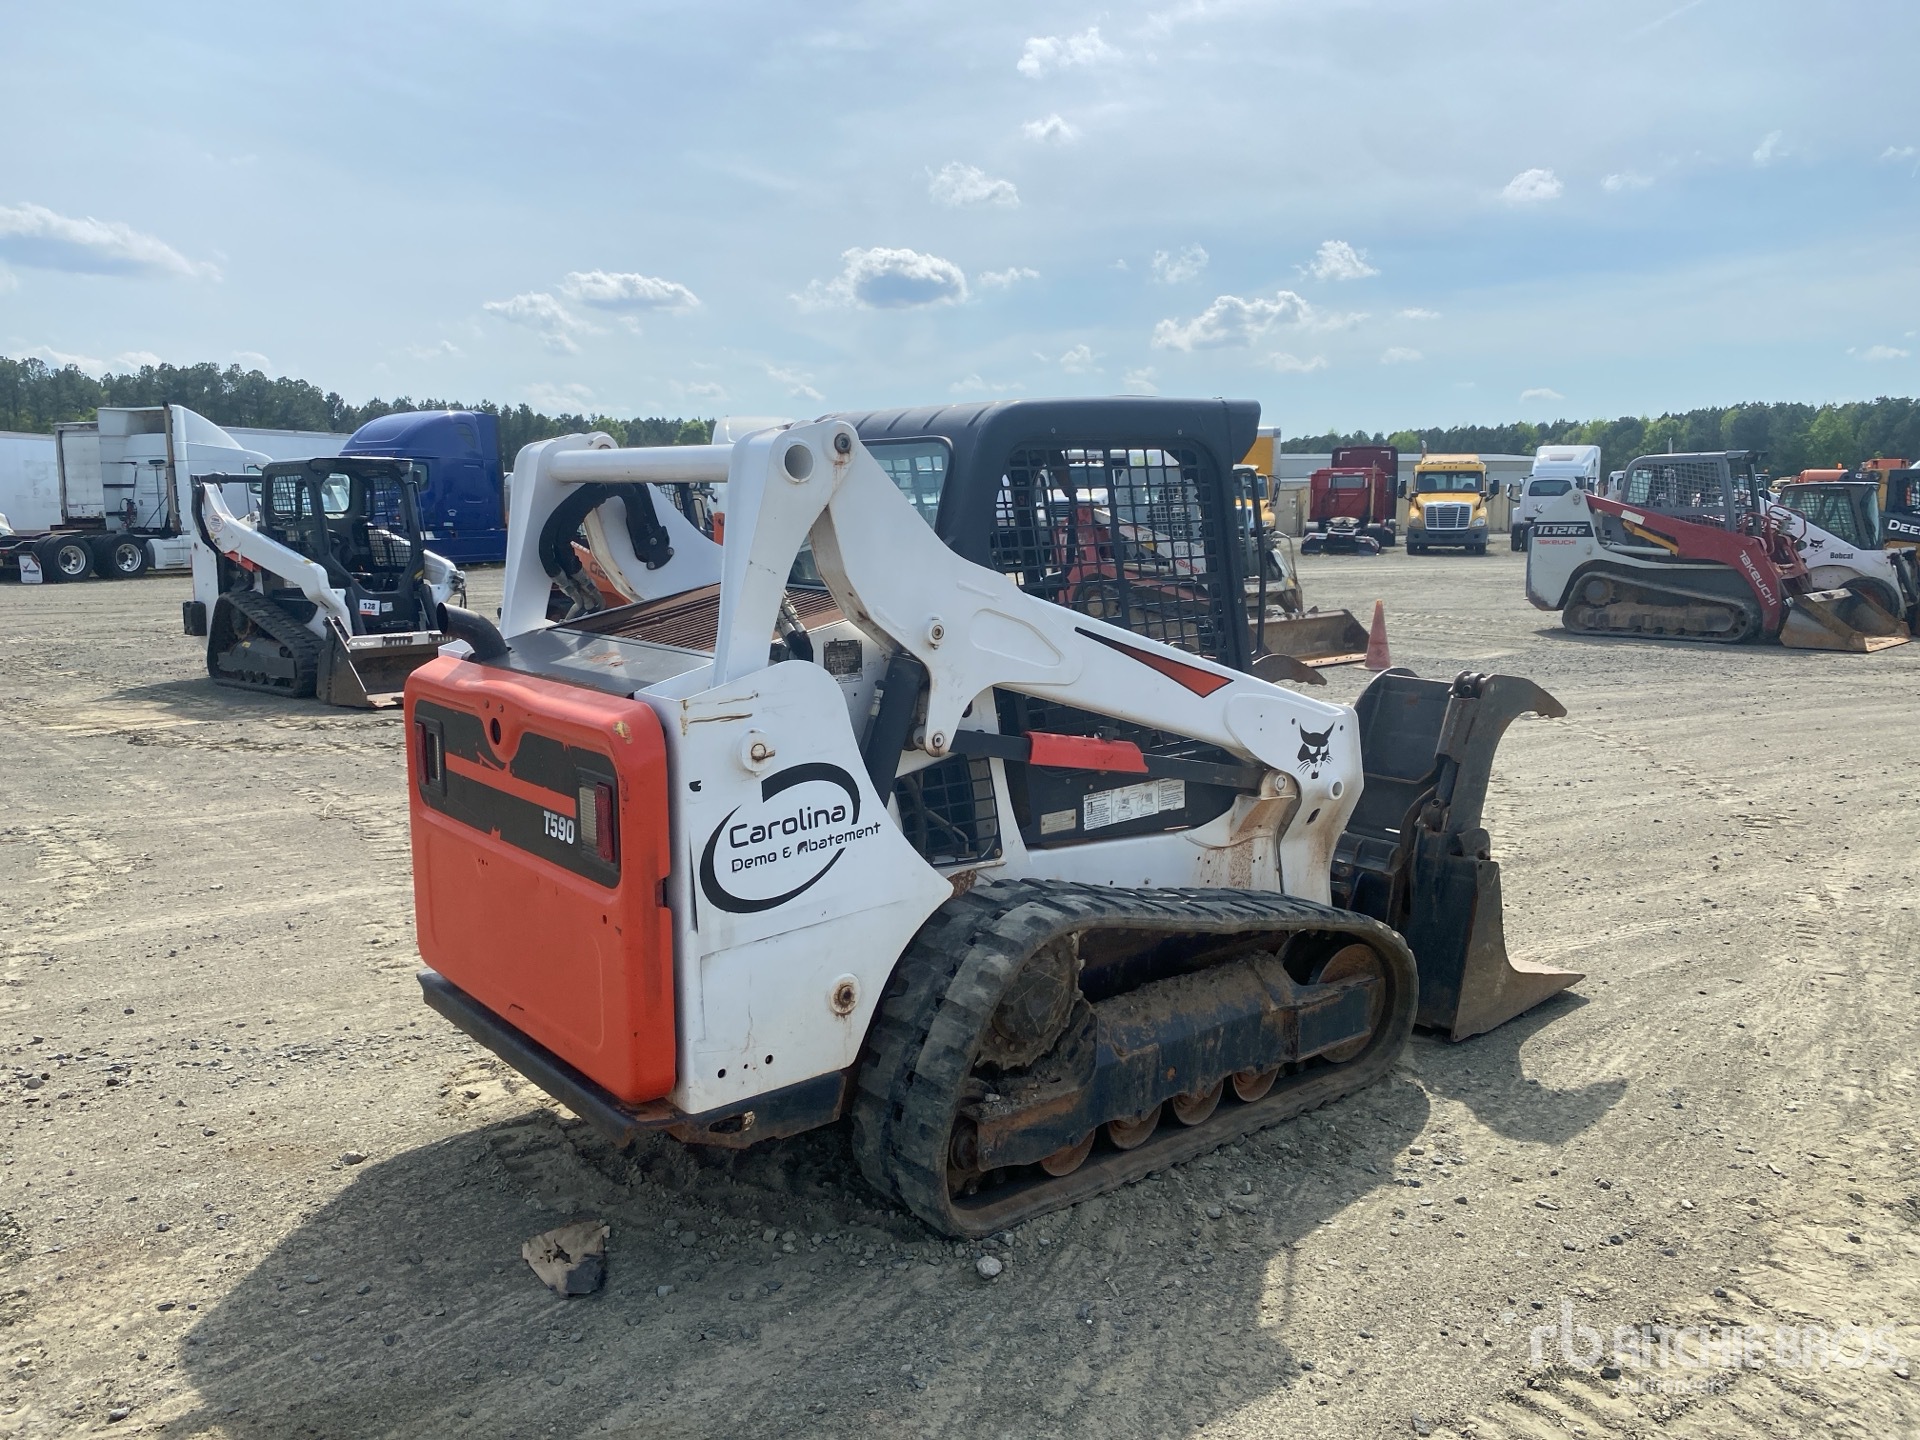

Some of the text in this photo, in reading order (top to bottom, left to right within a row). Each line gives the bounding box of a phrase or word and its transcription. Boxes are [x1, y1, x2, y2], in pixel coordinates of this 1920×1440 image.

[1888, 519, 1920, 536] DEE
[363, 602, 376, 611] 128
[543, 810, 575, 845] T590
[729, 804, 847, 849] Carolina
[731, 822, 881, 873] Demo & Abatement
